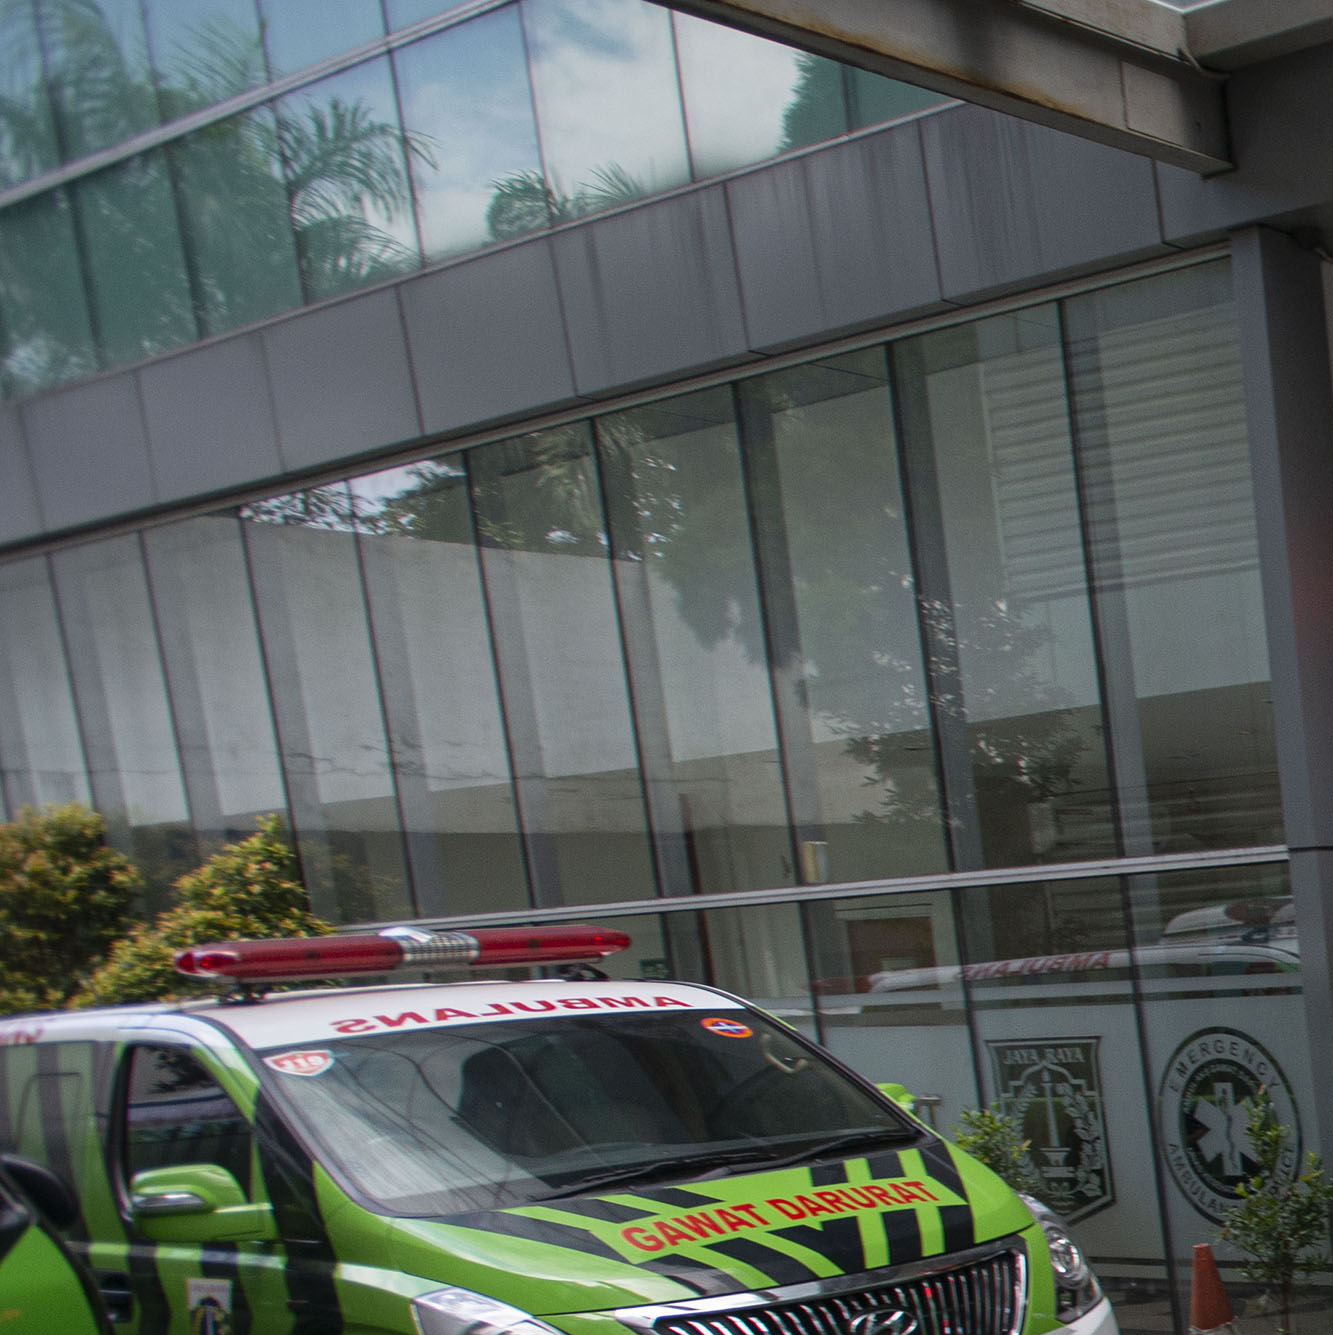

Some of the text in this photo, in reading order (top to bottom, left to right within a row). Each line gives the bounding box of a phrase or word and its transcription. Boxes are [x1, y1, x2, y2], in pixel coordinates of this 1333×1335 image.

[1001, 1047, 1085, 1065] JAYA RAYA
[1167, 1039, 1281, 1093] EMERGENCY
[620, 1181, 941, 1252] GAWAT DARURAT
